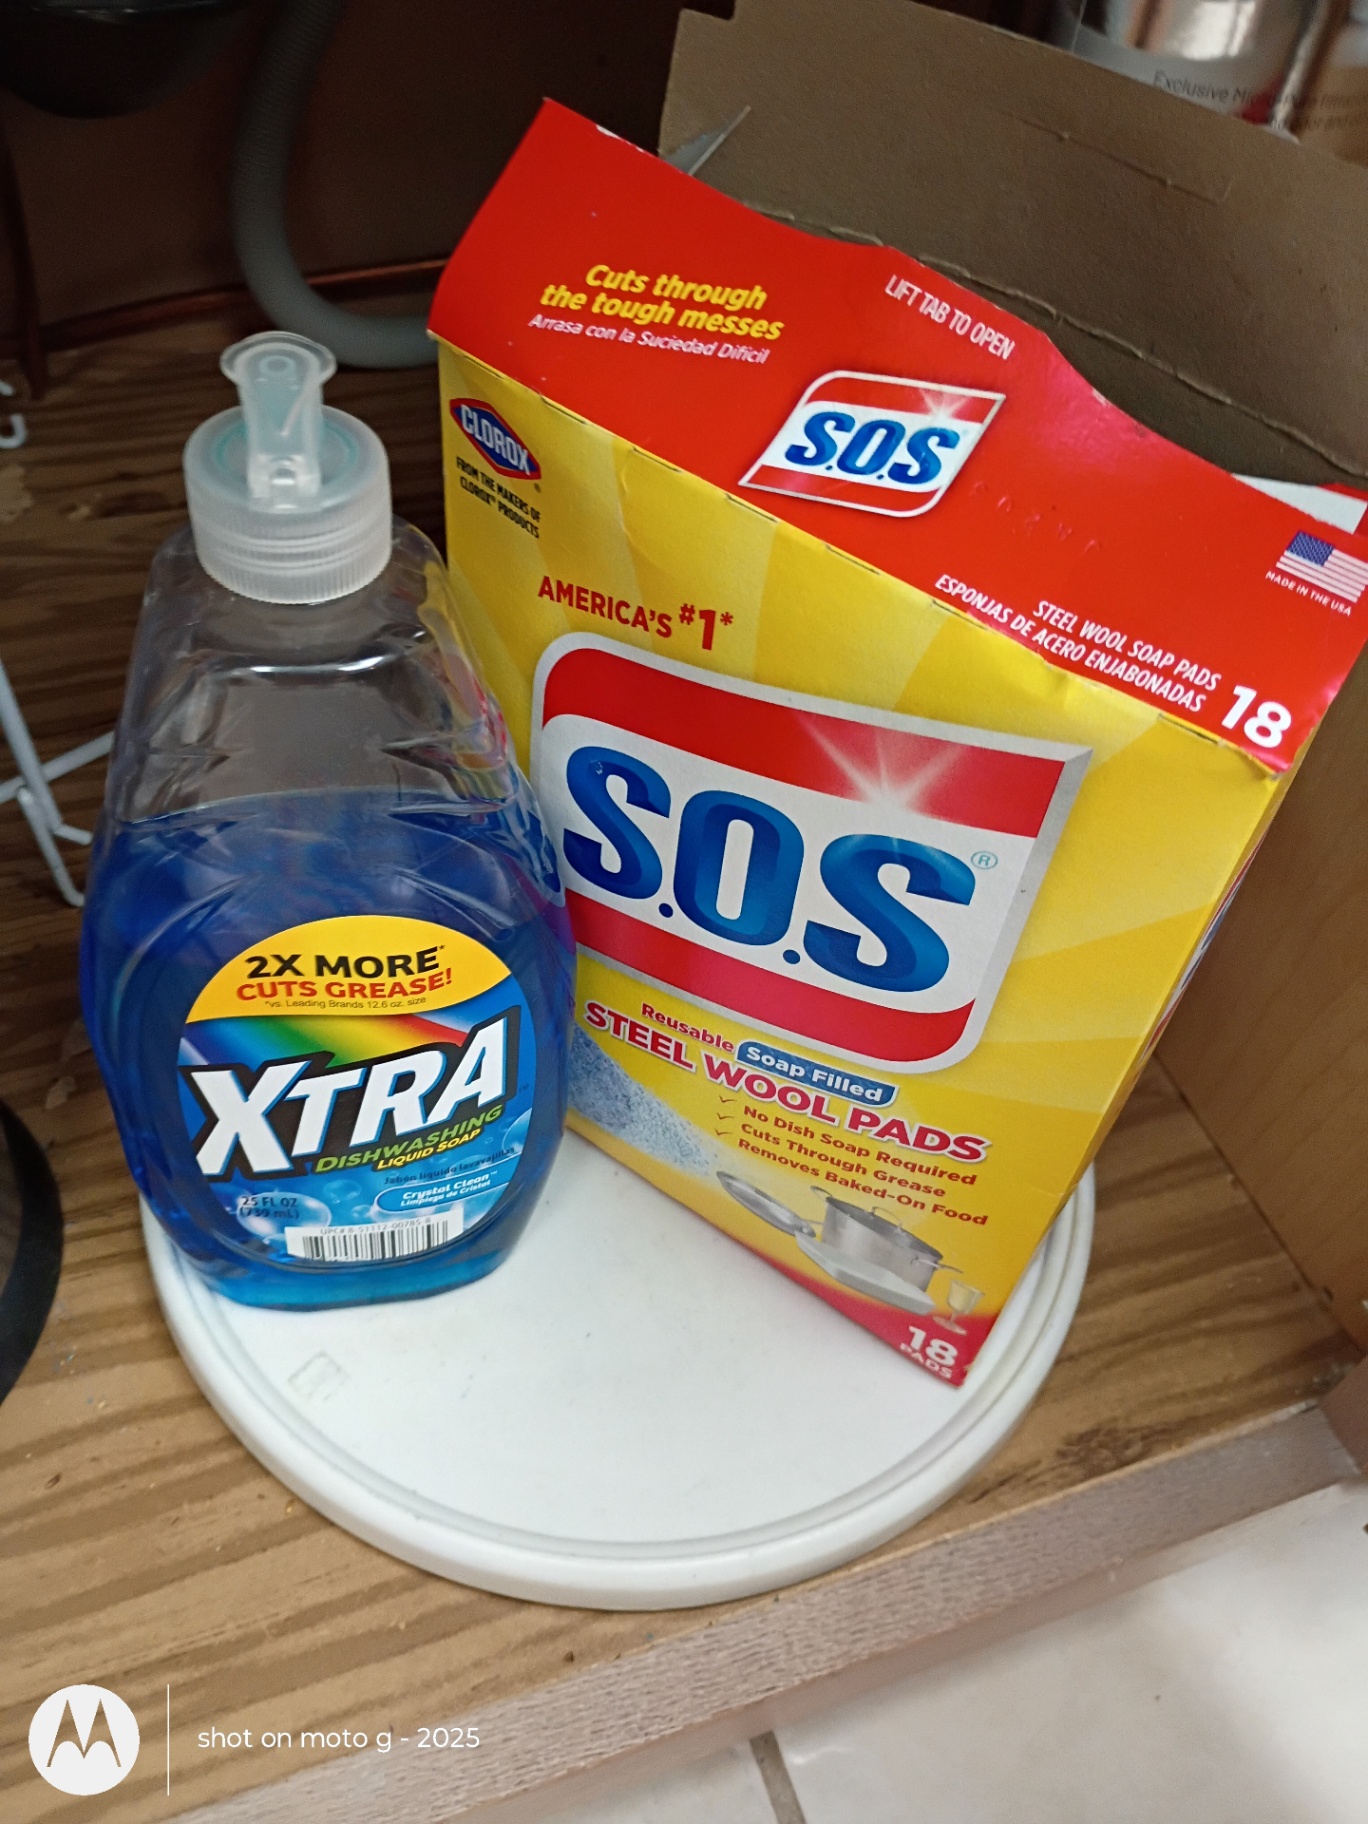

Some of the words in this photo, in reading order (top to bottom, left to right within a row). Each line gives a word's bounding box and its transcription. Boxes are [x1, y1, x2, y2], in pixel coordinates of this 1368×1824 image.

[540, 284, 588, 310] the
[591, 292, 676, 325] tough
[677, 308, 785, 340] messes
[586, 264, 650, 293] Cuts
[652, 273, 768, 311] through
[885, 274, 922, 307] LIFT
[919, 291, 951, 324] TAB
[948, 308, 972, 336] TO
[970, 321, 1016, 360] OPEN
[528, 313, 584, 334] Arrasa
[585, 324, 617, 340] con
[618, 327, 636, 343] la
[637, 330, 719, 356] Suciedad
[460, 404, 531, 476] CLOROX
[456, 456, 479, 481] FROM
[480, 471, 495, 492] THE
[497, 483, 529, 516] MAKERS
[530, 506, 541, 523] OF
[498, 500, 540, 539] PRODUCTS
[538, 575, 673, 639] AMERICA'S
[1265, 570, 1297, 591] MADE
[1296, 583, 1309, 597] IN
[1310, 589, 1331, 607] THE
[1330, 599, 1352, 617] USA
[935, 574, 1013, 624] ESPONJAS
[1010, 614, 1037, 637] DE
[1032, 628, 1087, 662] ACERO
[1084, 649, 1207, 713] ENJABONADAS
[1033, 600, 1078, 633] STEEL
[1079, 619, 1128, 653] WOOL
[1127, 640, 1175, 670] SOAP
[1173, 658, 1222, 692] PADS
[1221, 685, 1292, 749] 18
[236, 980, 317, 1001] CUTS
[324, 967, 453, 999] GREASE!
[245, 954, 305, 979] 2X
[286, 999, 326, 1009] Leading
[328, 999, 364, 1009] Brands
[367, 1000, 387, 1009] 12.6
[407, 996, 427, 1007] size
[585, 1001, 694, 1071] STEEL
[703, 1053, 837, 1125] WOOL
[847, 1106, 988, 1162] PADS
[641, 1002, 735, 1053] Reusable
[746, 1046, 806, 1078] Soap
[812, 1069, 883, 1102] Filled
[190, 1016, 510, 1177] XTRA
[315, 1104, 503, 1173] DISHWASHING
[377, 1146, 434, 1170] LIQUID
[436, 1128, 482, 1153] SOAP
[741, 1123, 781, 1146] Cuts
[786, 1139, 868, 1175] Through
[873, 1169, 946, 1197] Grease
[743, 1105, 769, 1123] No
[773, 1117, 815, 1139] Dish
[820, 1133, 870, 1159] Soap
[875, 1151, 978, 1186] Required
[241, 1195, 259, 1207] 25
[262, 1196, 278, 1208] FL
[281, 1197, 298, 1208] OZ
[403, 1182, 451, 1201] Crystal
[446, 1190, 459, 1198] de
[460, 1180, 491, 1195] Cristal
[738, 1138, 820, 1177] Removes
[825, 1171, 926, 1210] Baked-On
[931, 1204, 989, 1226] Food
[900, 1343, 953, 1379] PADS
[908, 1325, 959, 1367] 18
